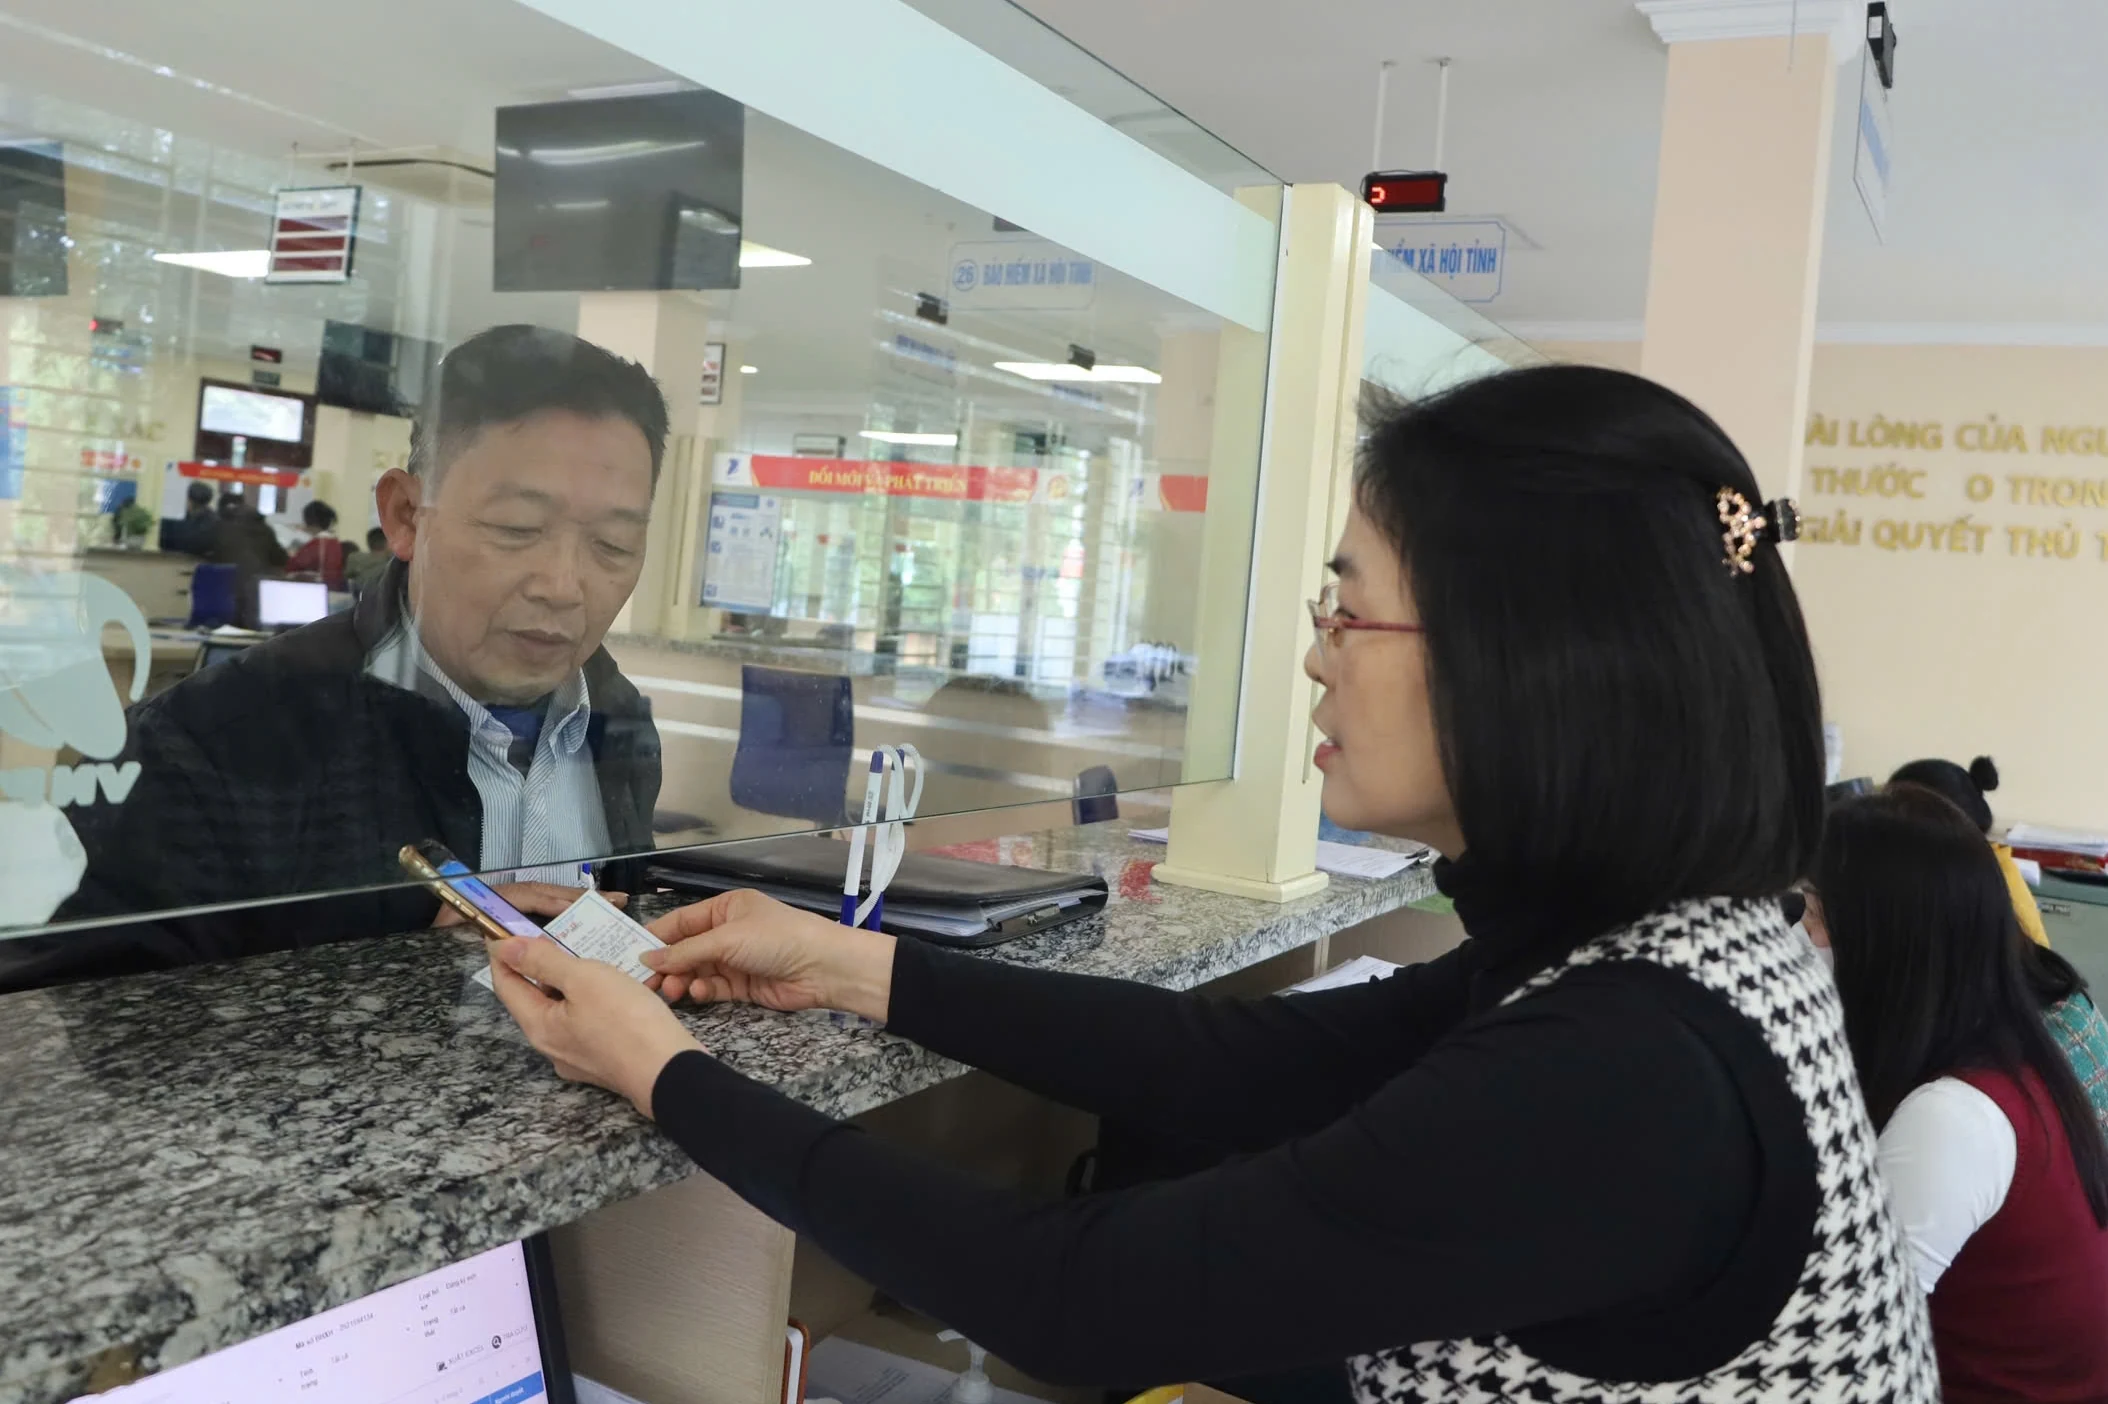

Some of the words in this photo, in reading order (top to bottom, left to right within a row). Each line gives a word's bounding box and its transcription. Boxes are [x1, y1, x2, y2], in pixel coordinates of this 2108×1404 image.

[1439, 243, 1462, 280] HỘI
[1466, 238, 1498, 274] TỈNH
[1848, 413, 1944, 451] LÒNG
[1955, 413, 2029, 453] CỦA
[1872, 514, 1993, 554] QUYẾT
[2005, 519, 2083, 560] THỦ
